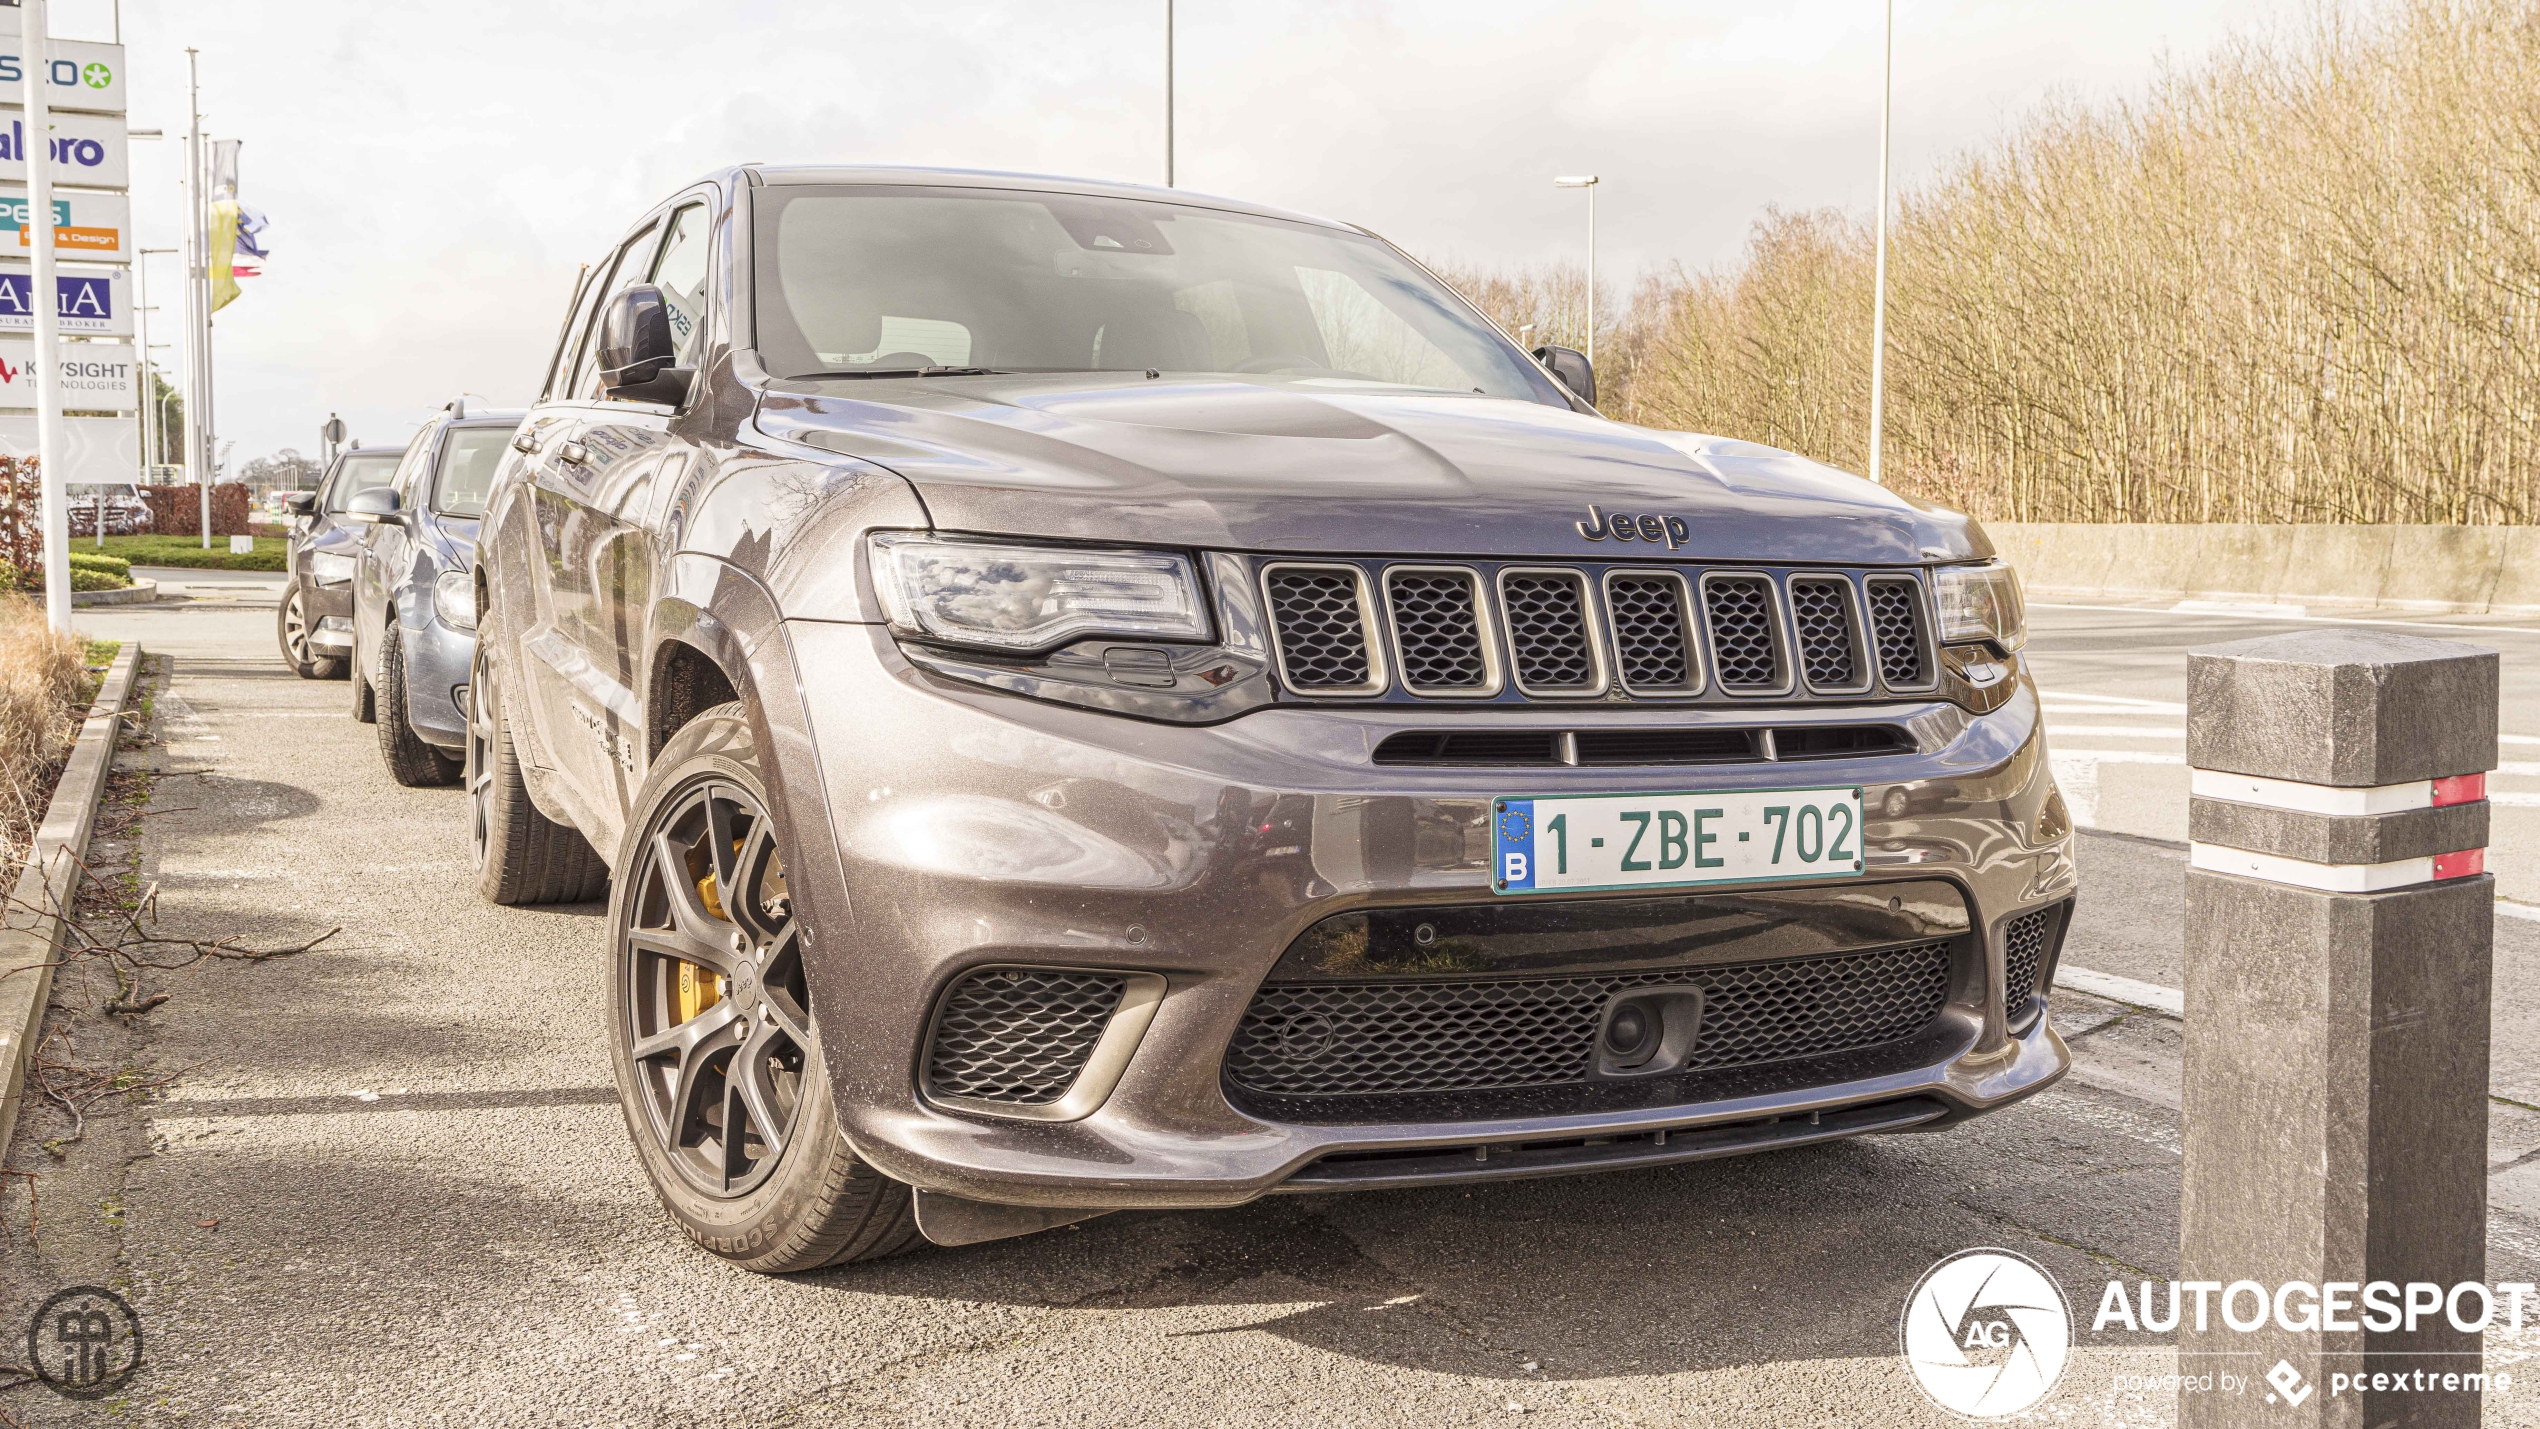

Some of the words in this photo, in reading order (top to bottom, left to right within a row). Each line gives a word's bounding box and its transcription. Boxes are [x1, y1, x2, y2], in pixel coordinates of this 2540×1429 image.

[0, 55, 78, 86] SO
[71, 233, 115, 244] Design
[0, 278, 106, 315] AIA
[59, 320, 106, 328] BROKER
[25, 361, 128, 378] KSIGHT
[26, 379, 127, 391] TNOLOGIES
[1576, 504, 1691, 551] Jeep
[1505, 852, 1528, 881] B
